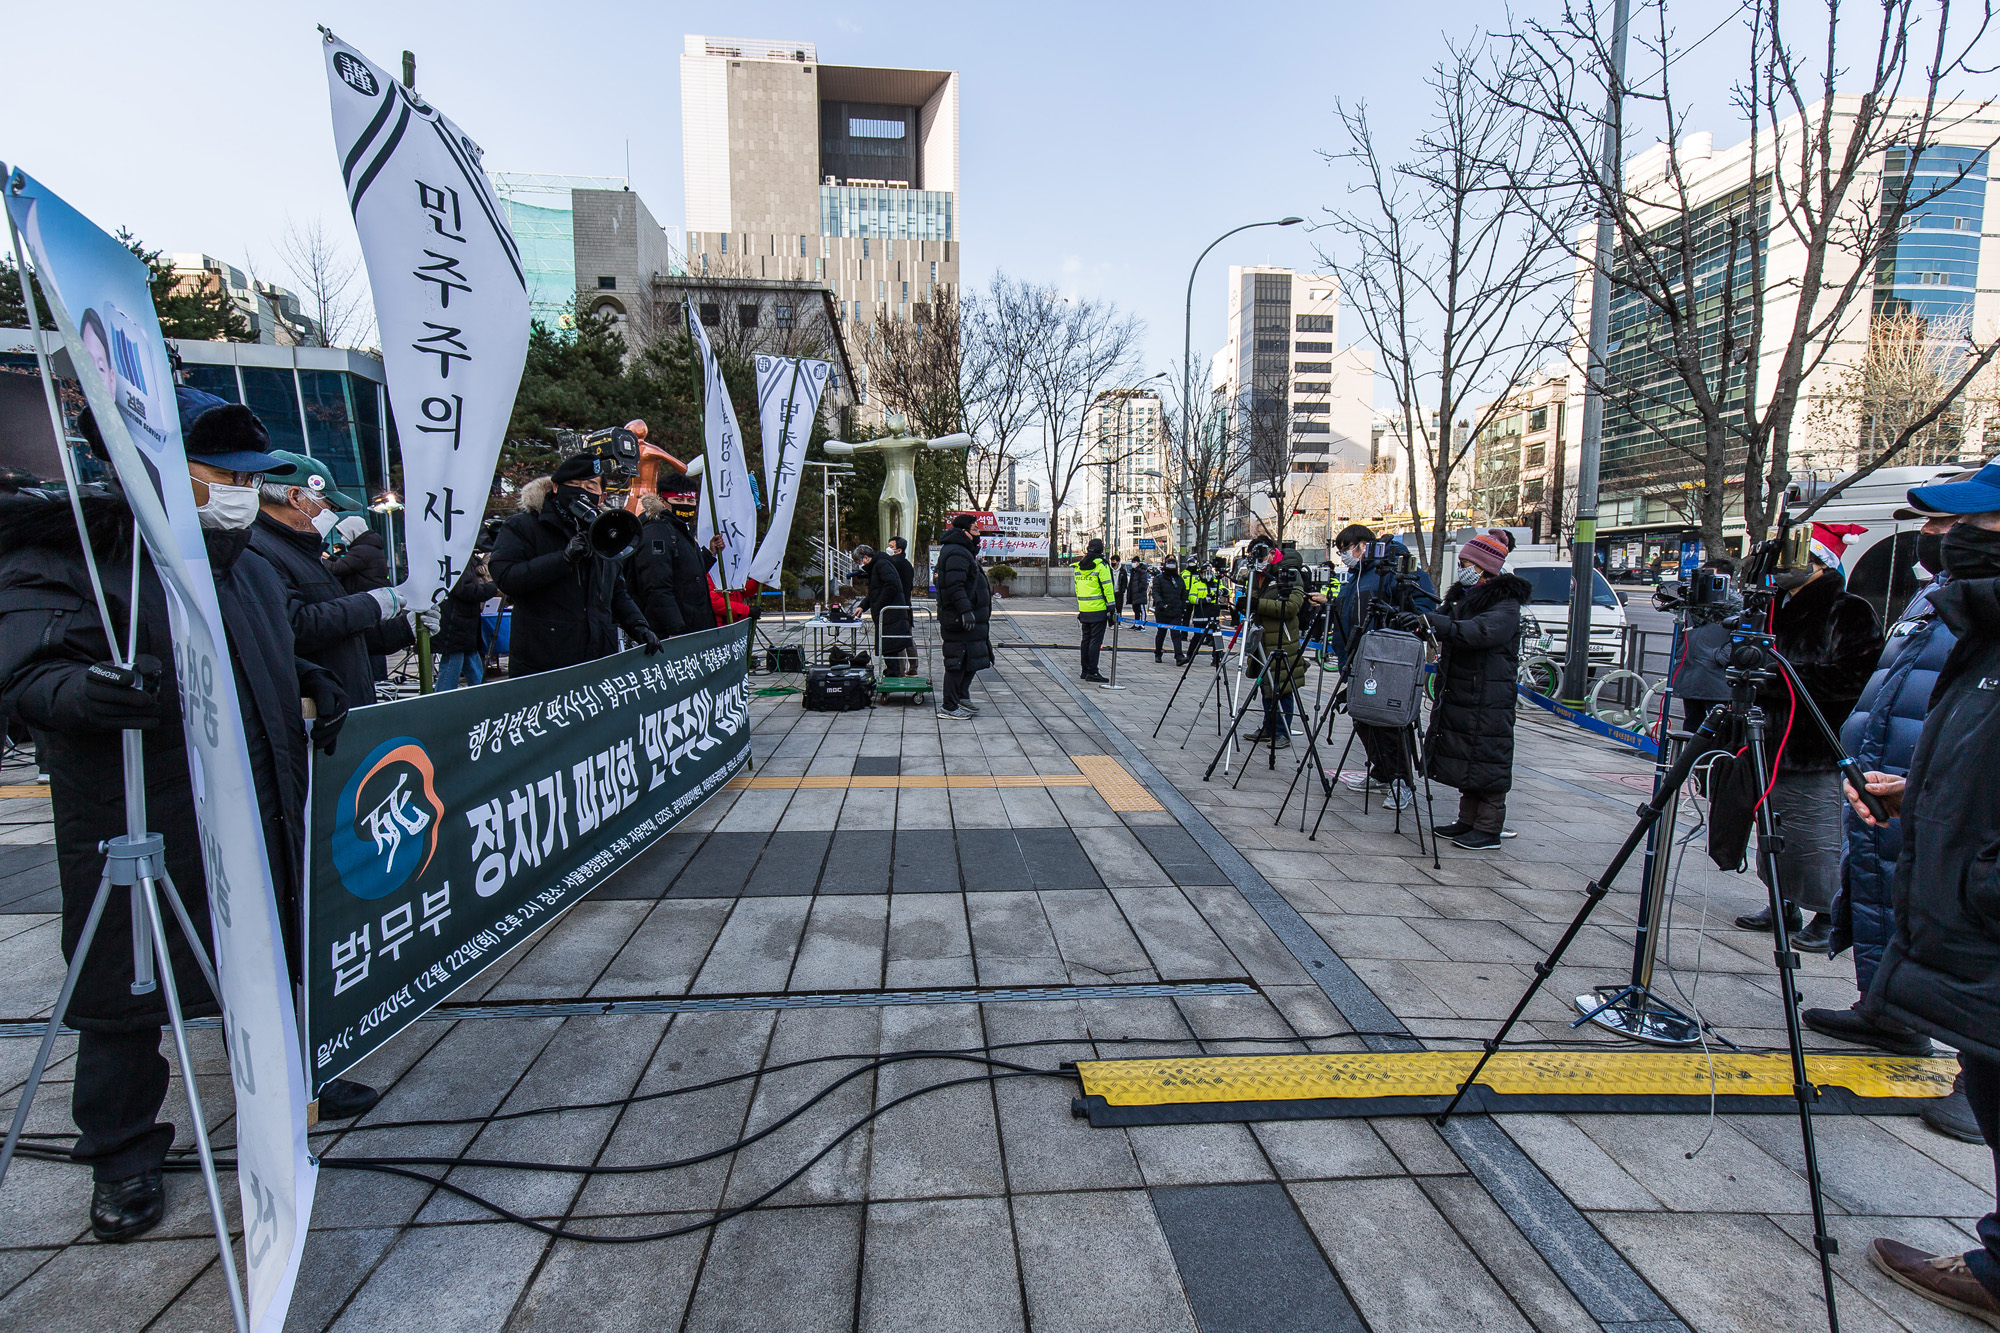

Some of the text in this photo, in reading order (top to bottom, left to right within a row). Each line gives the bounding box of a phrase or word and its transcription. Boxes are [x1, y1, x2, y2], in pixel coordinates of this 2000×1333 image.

[412, 179, 472, 451] 민주주의
[1024, 516, 1046, 526] 추미애
[468, 701, 547, 761] 행정법원
[546, 685, 603, 728] 판사님!
[598, 672, 641, 709] 법무부
[641, 664, 667, 693] 폭정
[664, 653, 704, 686] 바로잡아
[465, 770, 569, 897] 정치가
[573, 737, 639, 836] 파괴한
[317, 1026, 353, 1069] 일시:
[359, 984, 415, 1036] 2020년
[413, 961, 451, 993] 12월
[445, 929, 501, 971] 22일(화)
[495, 914, 523, 936] 오후
[517, 900, 544, 919] 2시
[536, 884, 566, 905] 장소:
[562, 849, 615, 886] 서울행정법원
[609, 837, 632, 856] 주최:
[627, 818, 658, 843] 자유연대,
[655, 807, 674, 825] GZSS,
[331, 880, 452, 997] 법무부
